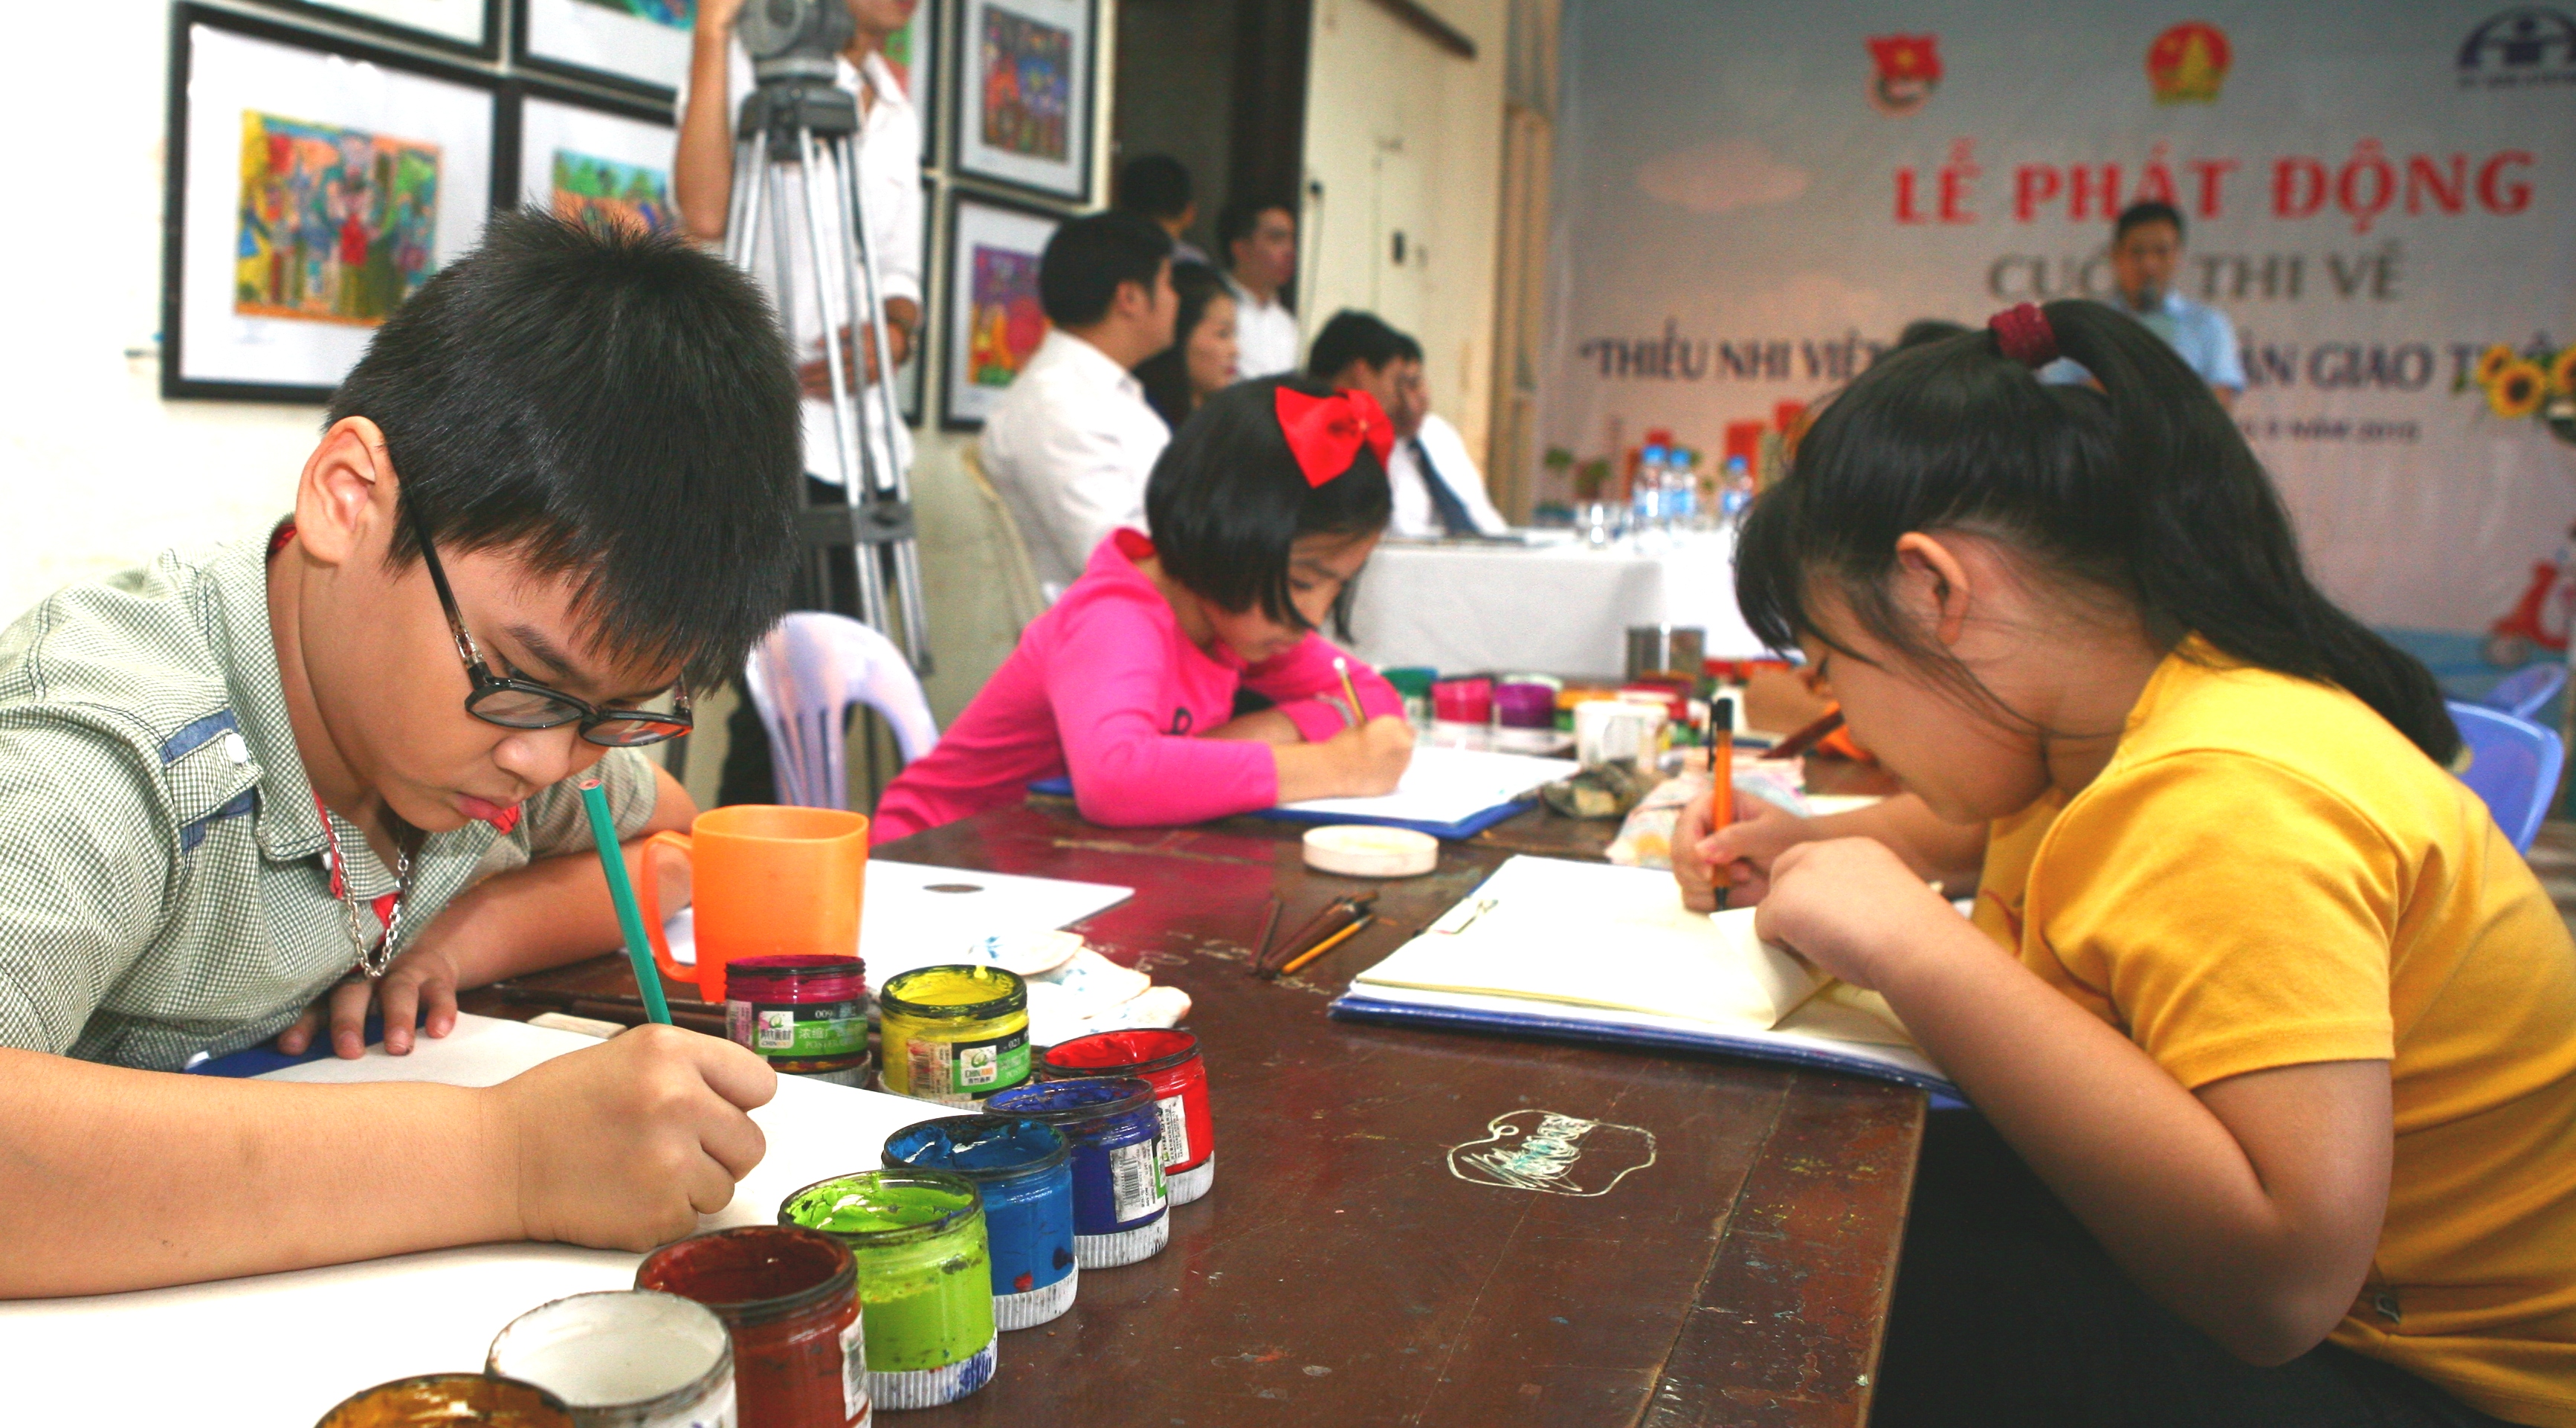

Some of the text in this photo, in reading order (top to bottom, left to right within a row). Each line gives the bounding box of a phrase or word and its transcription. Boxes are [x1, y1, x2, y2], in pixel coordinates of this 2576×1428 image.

[2012, 139, 2239, 222] PHÁT
[2271, 136, 2538, 234] ĐỘNG
[2196, 251, 2304, 300] THI
[2308, 340, 2435, 392] GIAO
